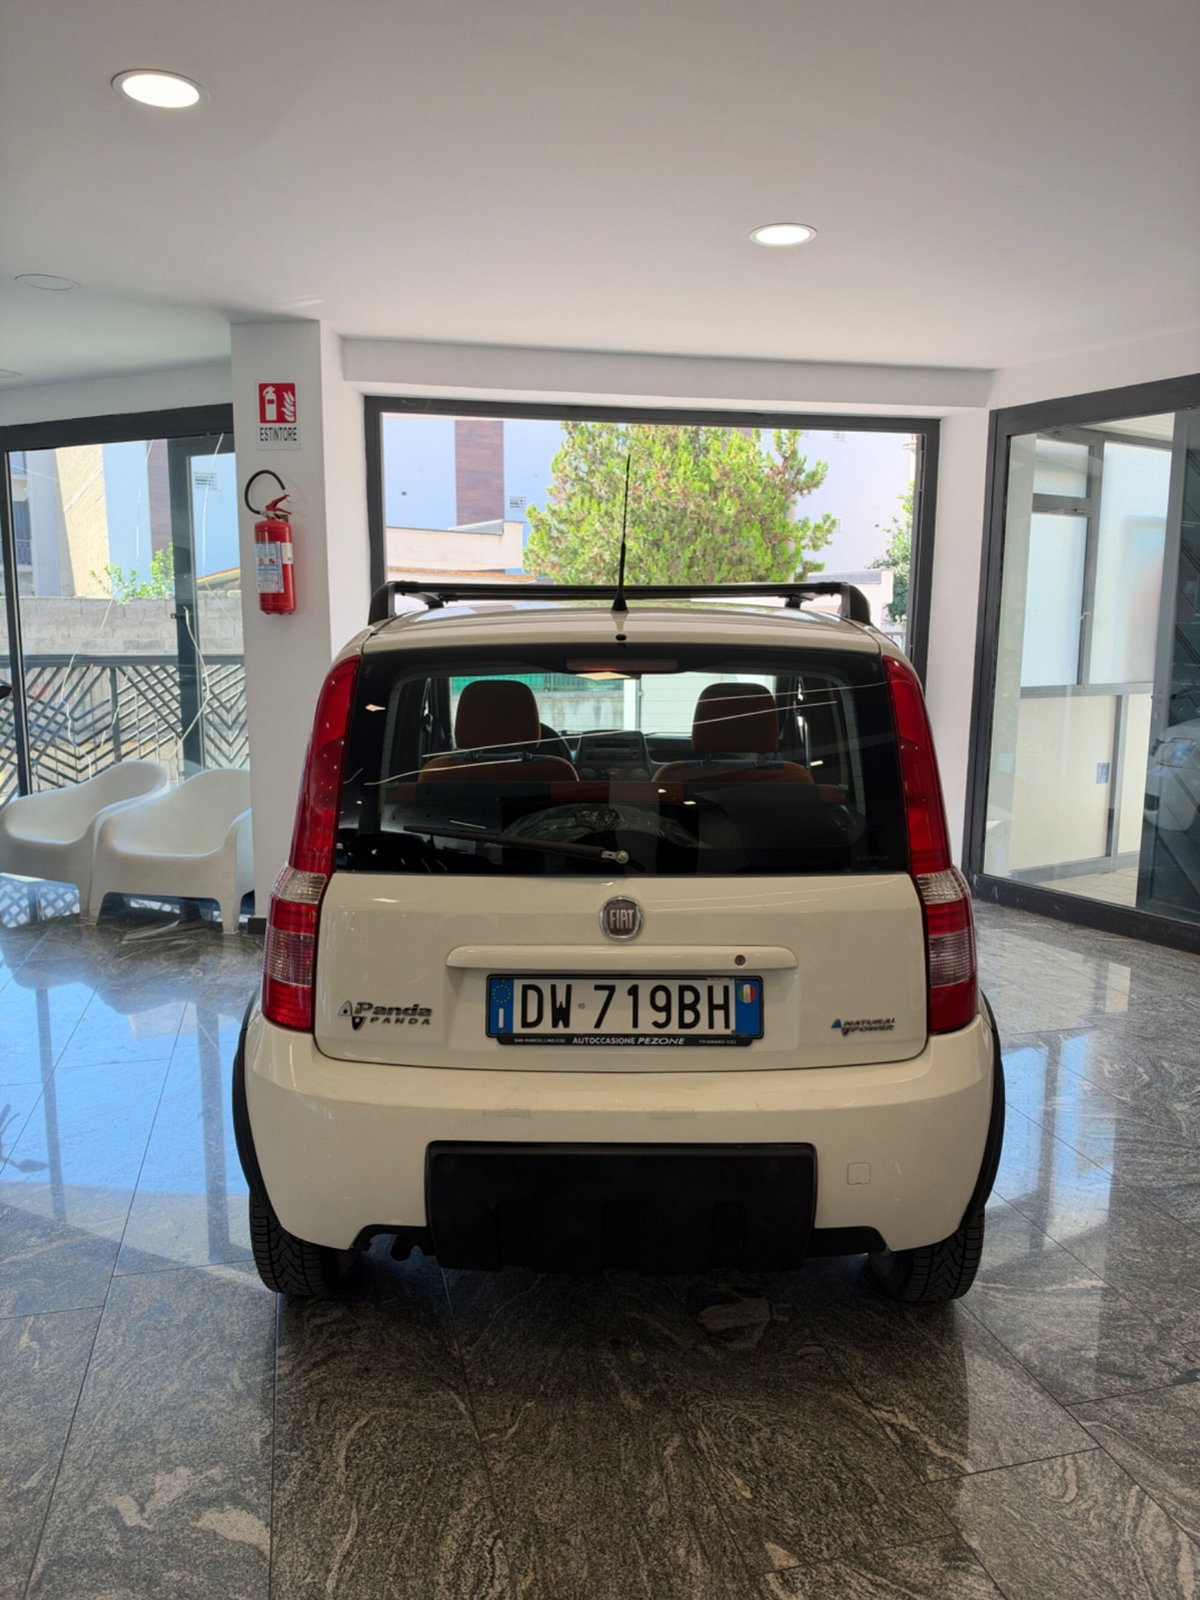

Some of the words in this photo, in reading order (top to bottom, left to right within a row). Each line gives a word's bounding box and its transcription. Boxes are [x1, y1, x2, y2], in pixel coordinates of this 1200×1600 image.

[259, 427, 298, 442] ESTINTORE
[609, 909, 635, 929] FIAT
[354, 1002, 432, 1017] Panda
[520, 983, 572, 1029] DW
[593, 984, 731, 1030] 719BH
[370, 1017, 431, 1025] PANDA
[843, 1017, 896, 1026] NATURAL
[573, 1037, 636, 1046] AUTOCCASIONE
[637, 1036, 686, 1046] PEZONE
